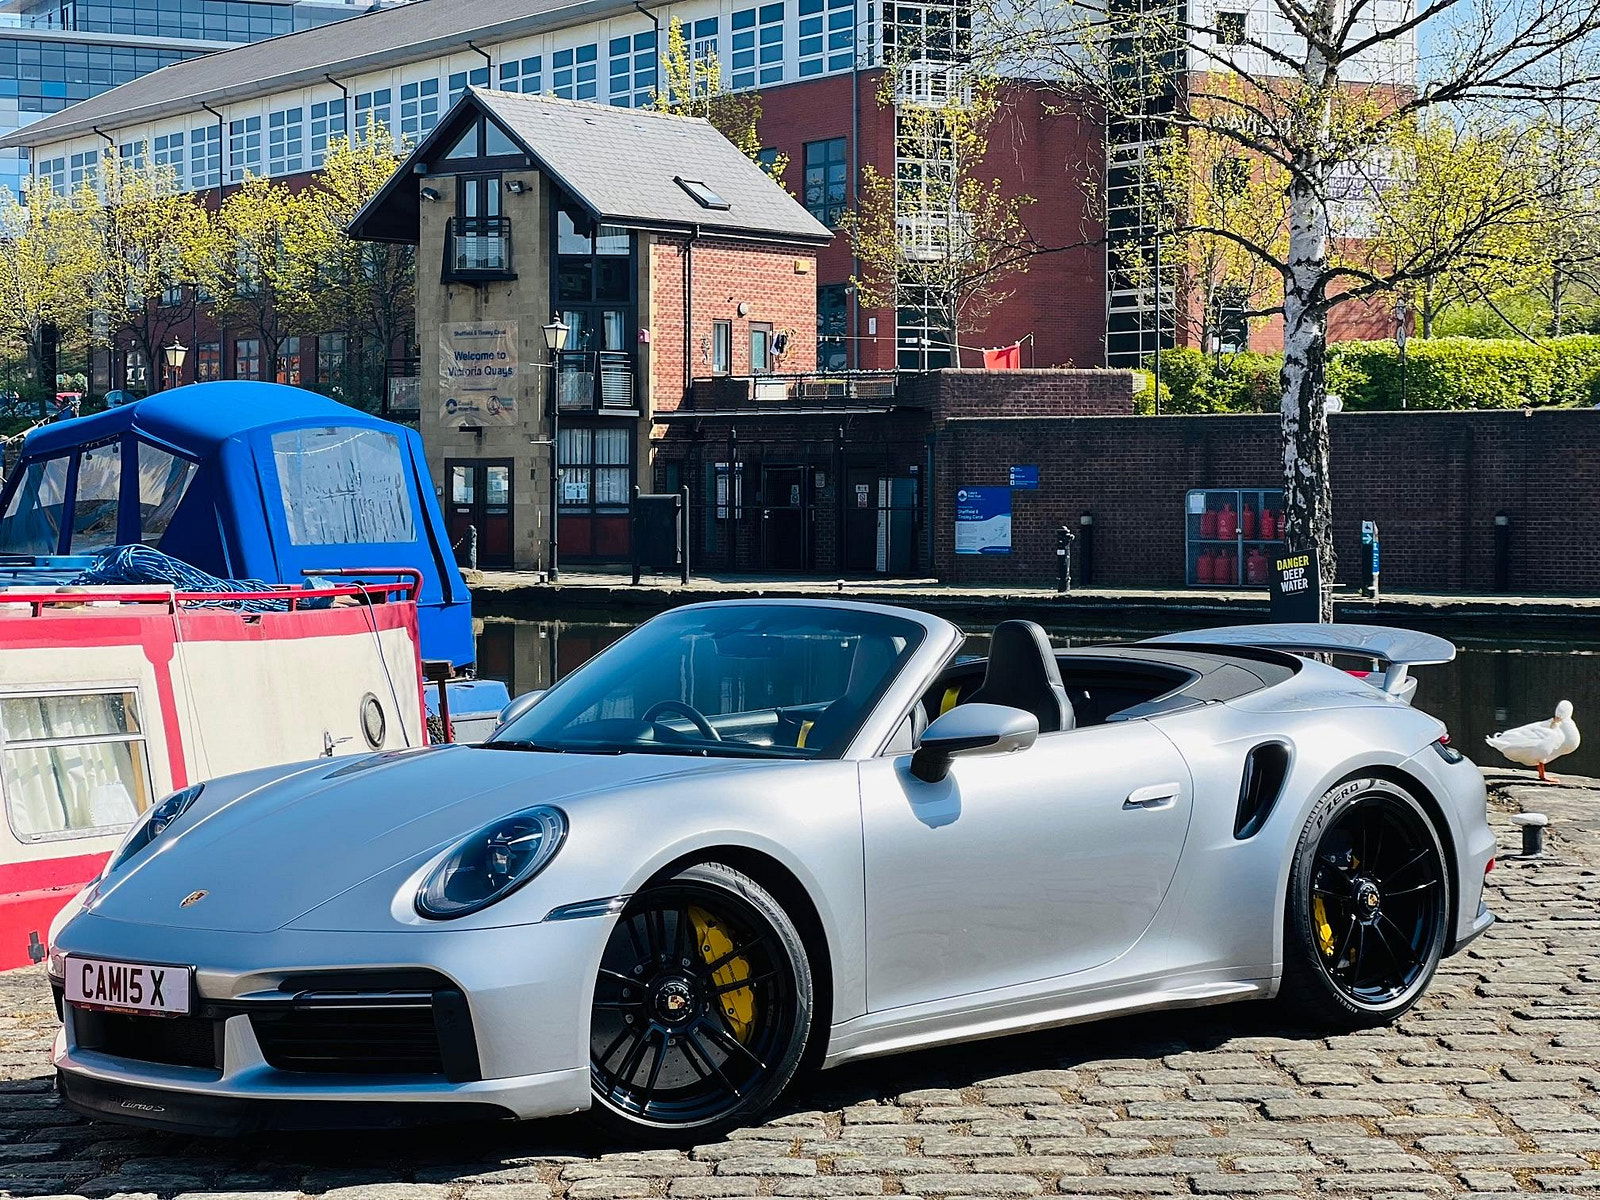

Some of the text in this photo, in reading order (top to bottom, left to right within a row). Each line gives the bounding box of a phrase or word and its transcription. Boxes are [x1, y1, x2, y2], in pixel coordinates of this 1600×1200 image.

[454, 350, 507, 361] Welcome to
[447, 365, 513, 378] Victoria Quays
[1276, 555, 1310, 571] DANGER
[1283, 567, 1305, 581] DEEP
[1280, 578, 1309, 592] WATER
[1317, 783, 1359, 829] P ZERO
[150, 969, 165, 1007] X
